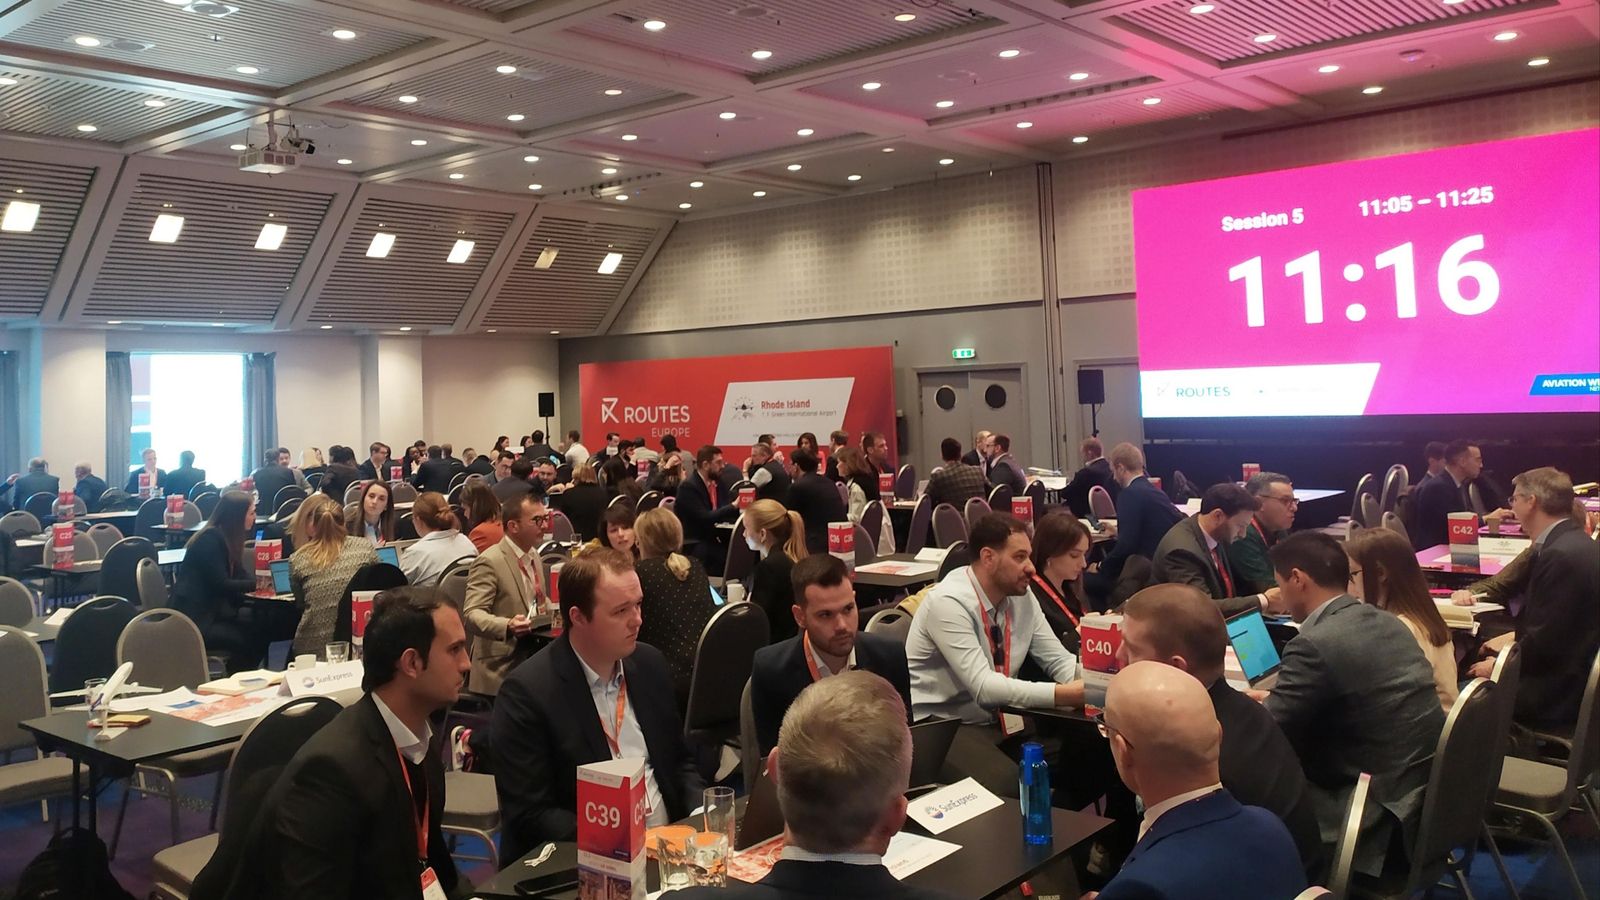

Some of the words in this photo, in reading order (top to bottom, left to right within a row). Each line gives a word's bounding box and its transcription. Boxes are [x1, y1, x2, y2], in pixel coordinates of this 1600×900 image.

[1358, 195, 1413, 216] 11:05
[1436, 186, 1494, 208] 11:25
[1221, 211, 1289, 232] Session
[1292, 207, 1305, 225] 5
[1228, 234, 1501, 328] 11:16
[1542, 379, 1586, 387] AVIATION
[1175, 386, 1231, 398] ROUTES
[761, 400, 785, 409] Rhode
[786, 399, 811, 409] Island
[624, 405, 691, 424] ROUTES
[651, 427, 691, 438] EUROPE
[1014, 506, 1029, 515] C35
[59, 531, 74, 540] C25
[1452, 525, 1474, 535] C42
[257, 552, 270, 561] C28
[1086, 638, 1112, 656] C40
[315, 671, 354, 684] SunExpress
[939, 793, 978, 812] SunExpress
[584, 801, 621, 829] C39
